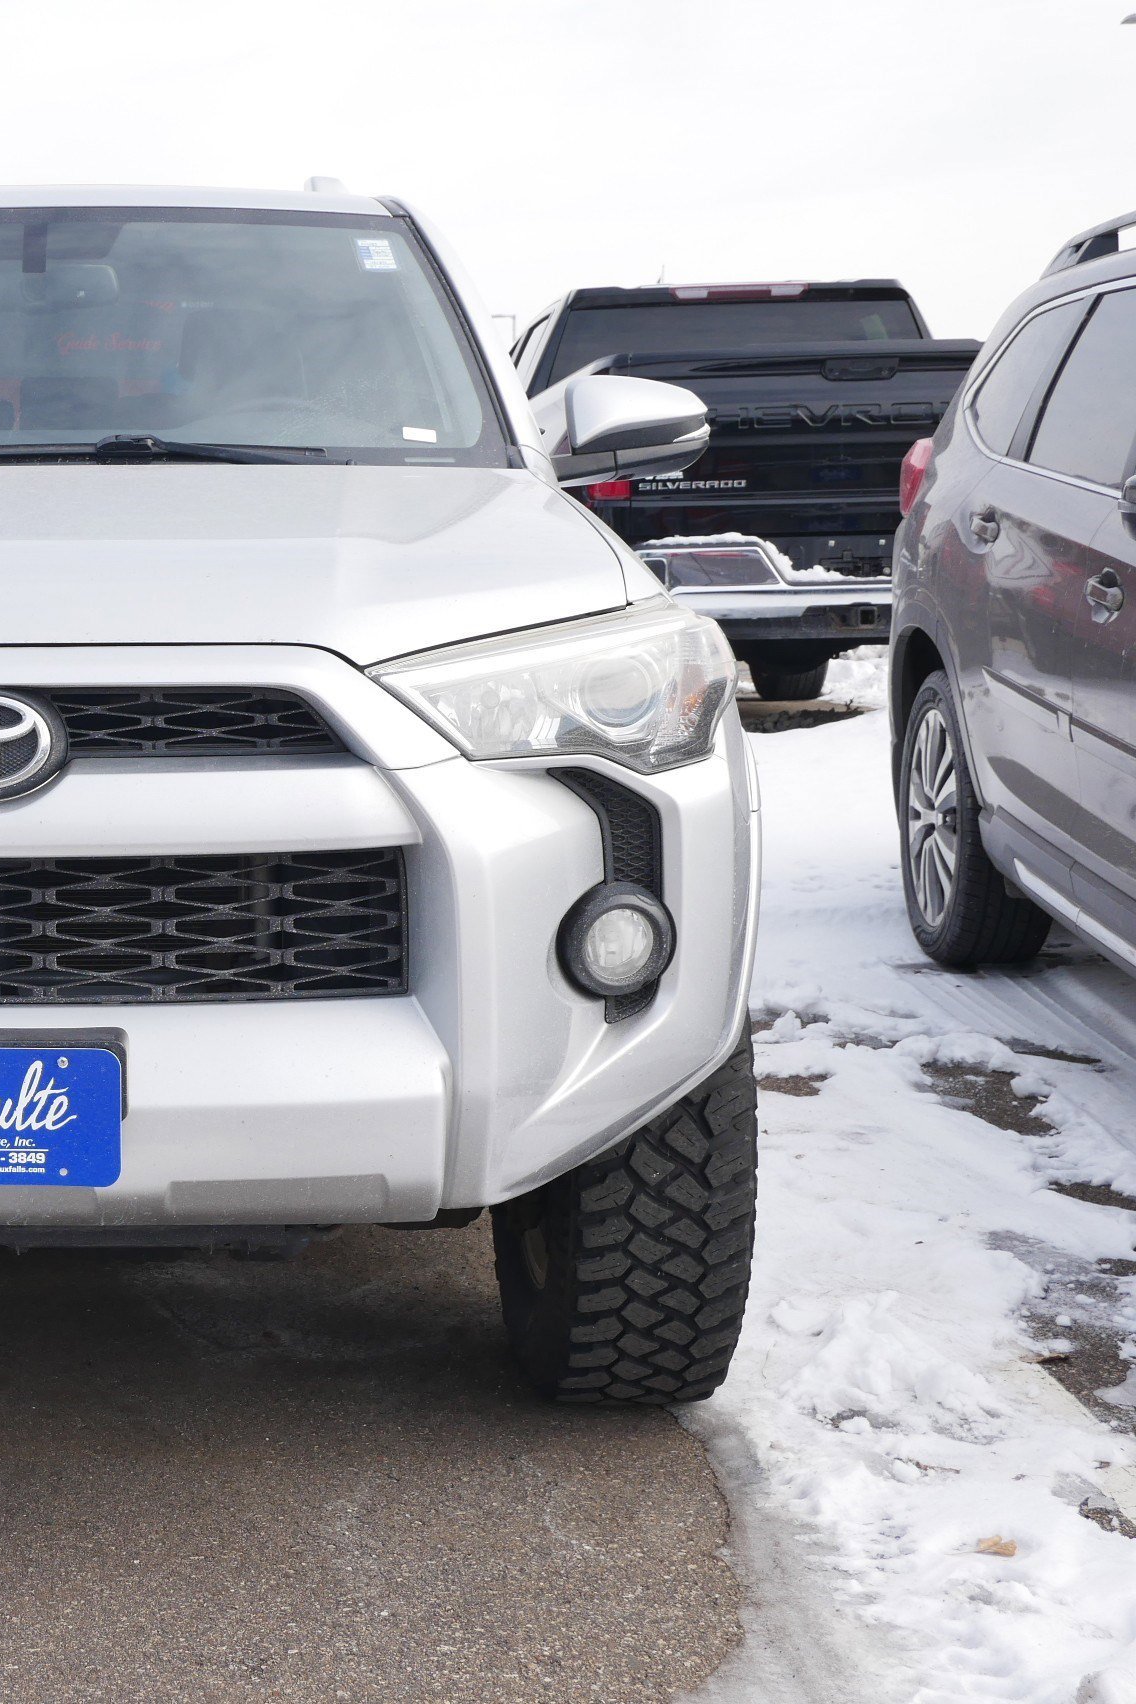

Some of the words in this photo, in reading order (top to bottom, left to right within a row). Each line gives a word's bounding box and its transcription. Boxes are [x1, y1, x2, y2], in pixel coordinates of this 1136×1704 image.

[638, 480, 746, 490] SILVERADO
[14, 1136, 36, 1147] Inc.
[8, 1152, 46, 1164] 3849
